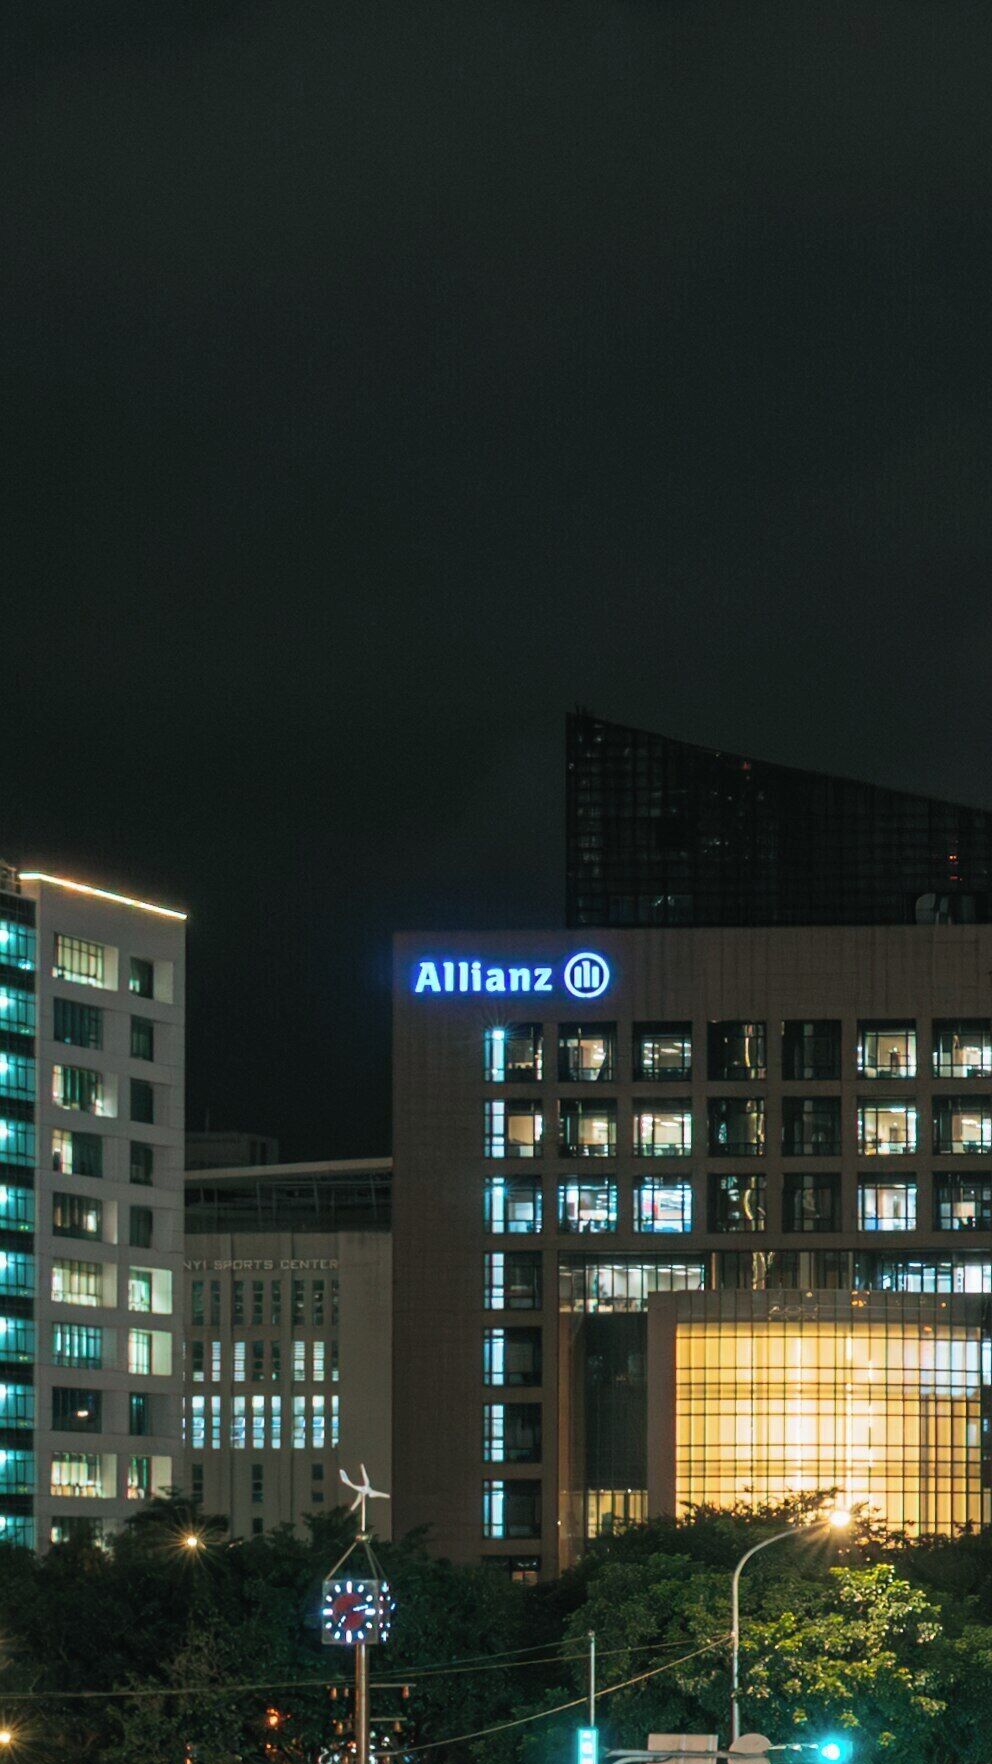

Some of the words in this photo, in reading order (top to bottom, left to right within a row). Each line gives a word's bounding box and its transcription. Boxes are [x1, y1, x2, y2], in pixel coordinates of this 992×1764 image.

[414, 961, 552, 992] Allianz
[213, 1259, 274, 1270] SPORTS
[280, 1258, 339, 1270] CENTER
